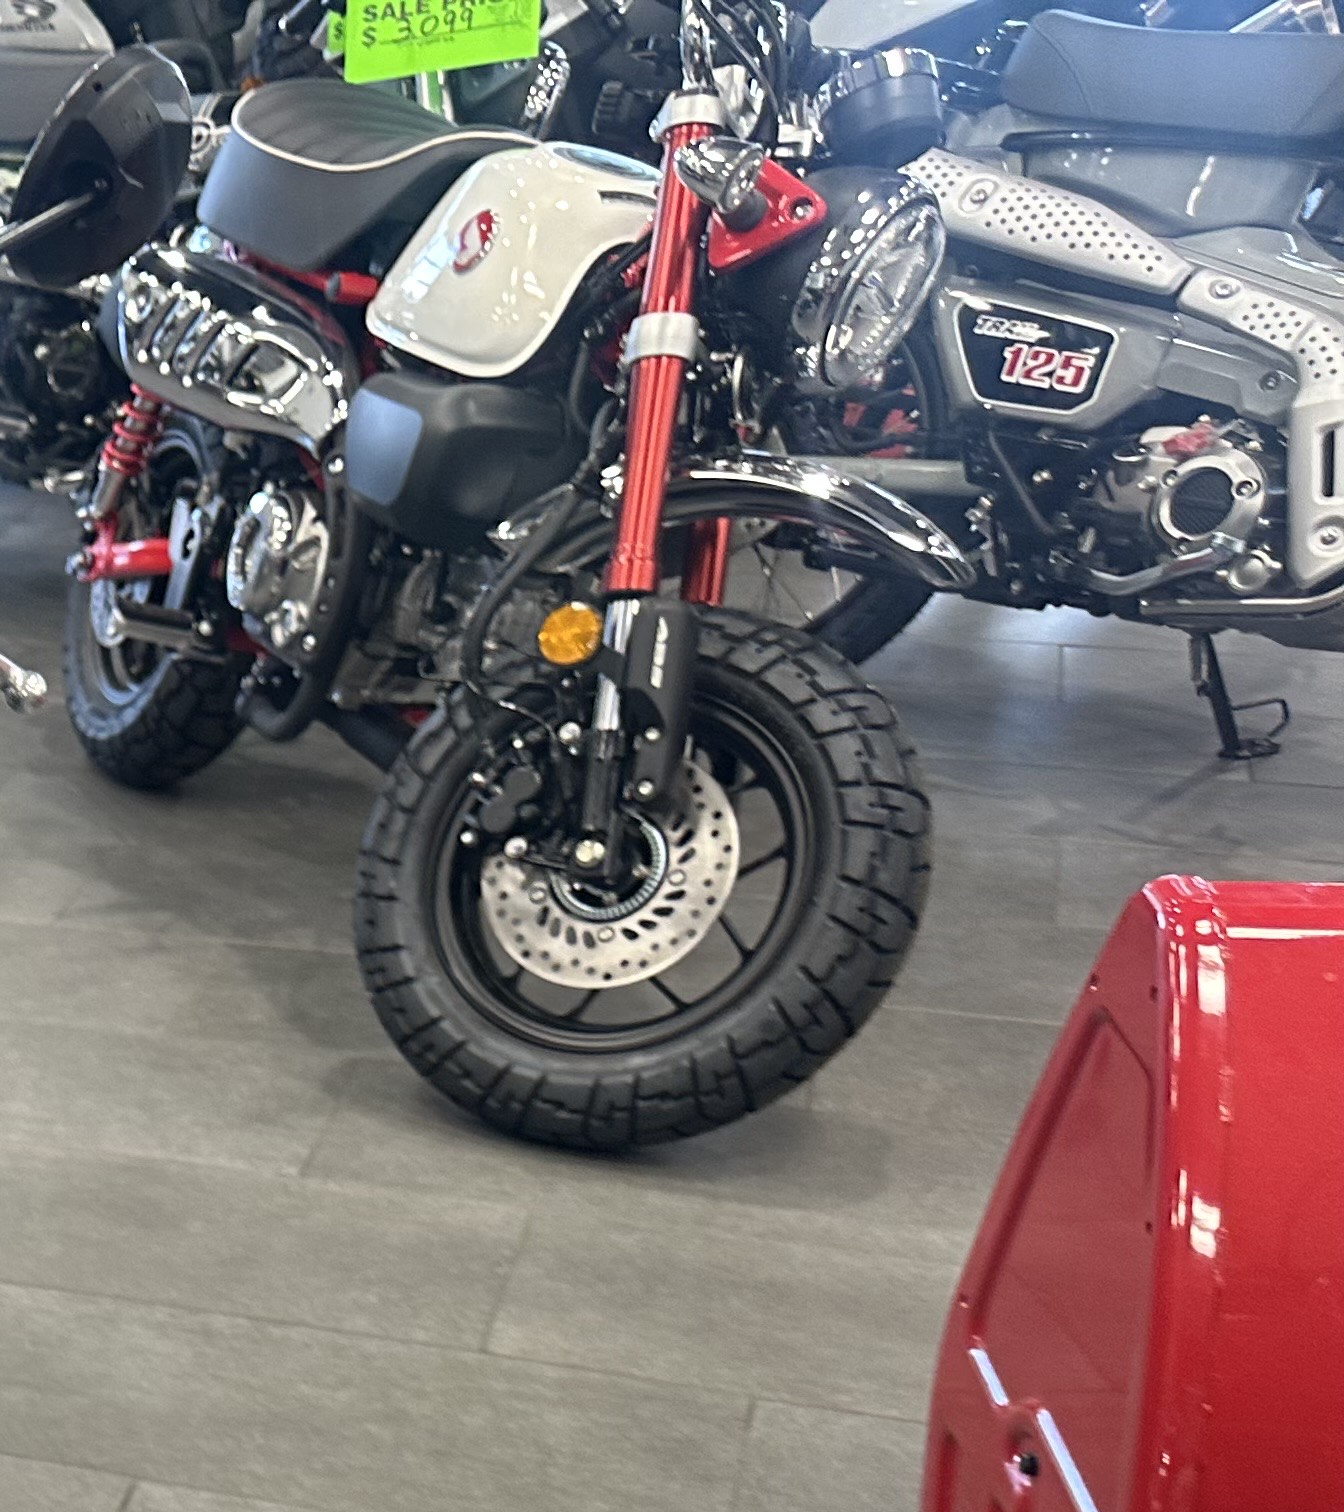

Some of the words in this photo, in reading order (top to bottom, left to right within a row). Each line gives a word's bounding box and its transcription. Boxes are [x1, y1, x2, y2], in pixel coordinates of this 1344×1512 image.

[363, 0, 431, 22] SALE
[362, 26, 377, 48] $
[1000, 342, 1095, 394] 125
